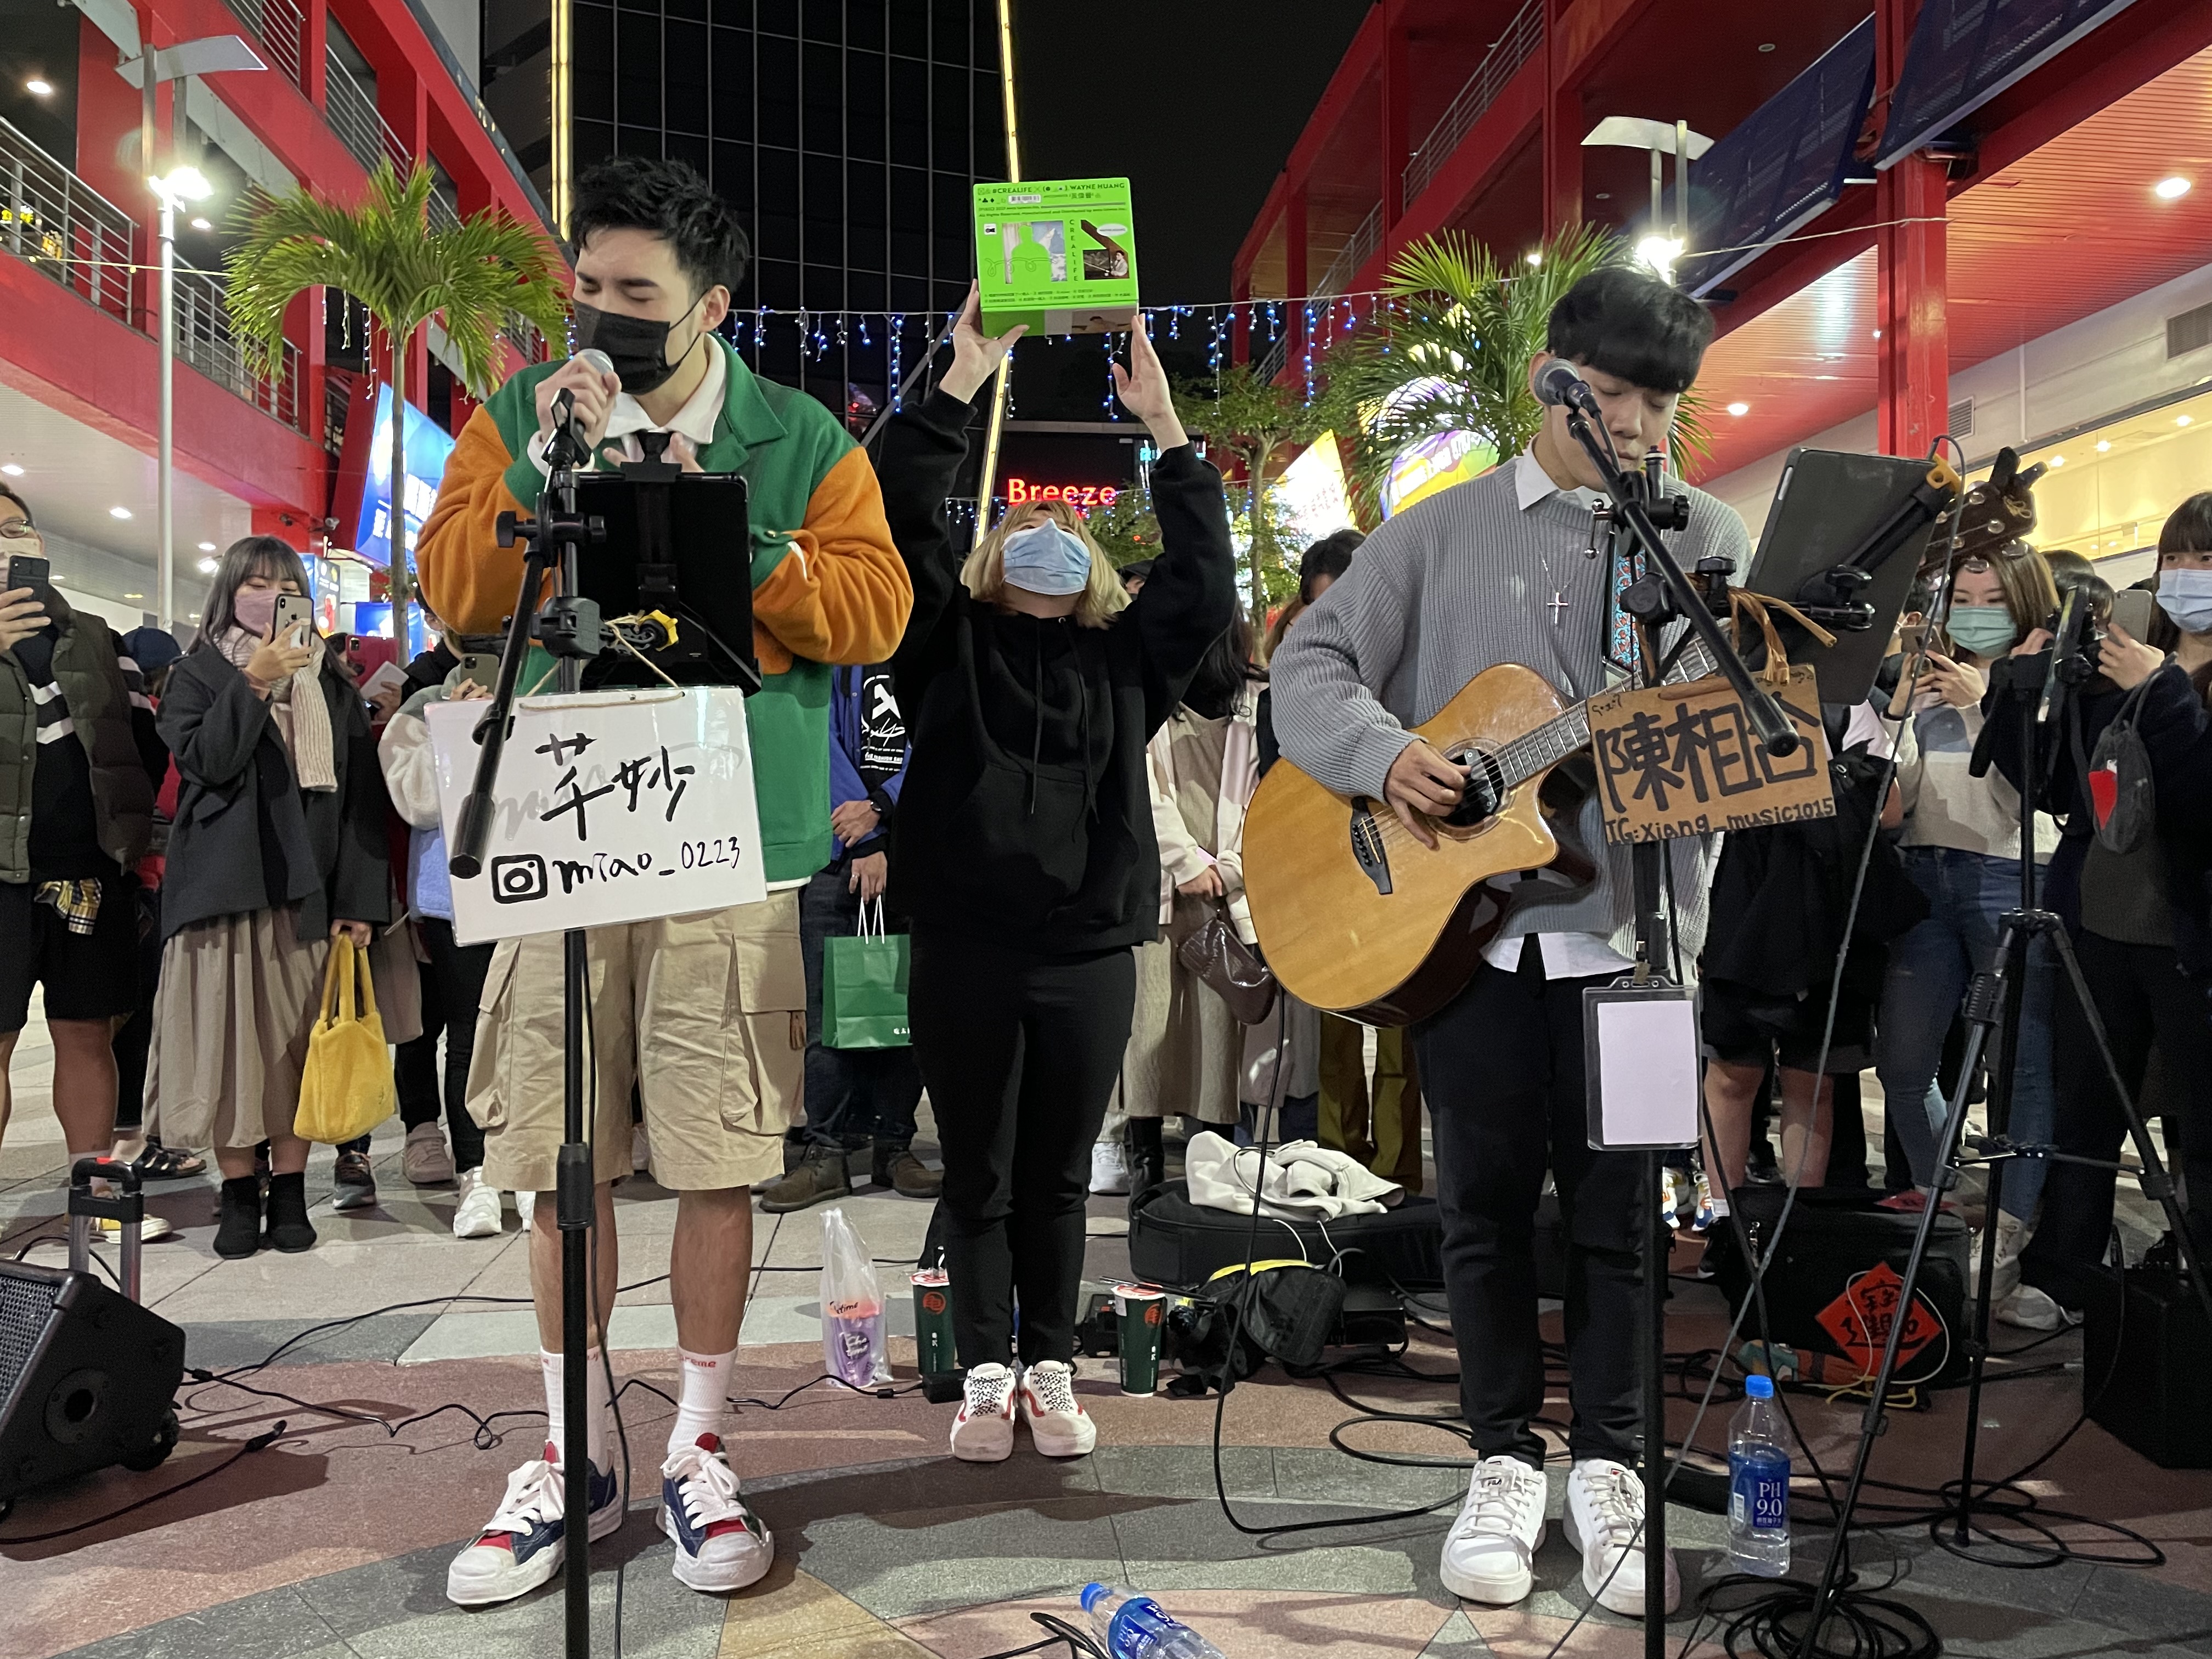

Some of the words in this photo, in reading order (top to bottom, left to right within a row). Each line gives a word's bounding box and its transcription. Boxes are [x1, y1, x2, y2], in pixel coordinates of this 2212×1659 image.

[1008, 478, 1117, 505] Breeze
[1759, 1482, 1780, 1498] PH
[1757, 1498, 1782, 1516] 9.0
